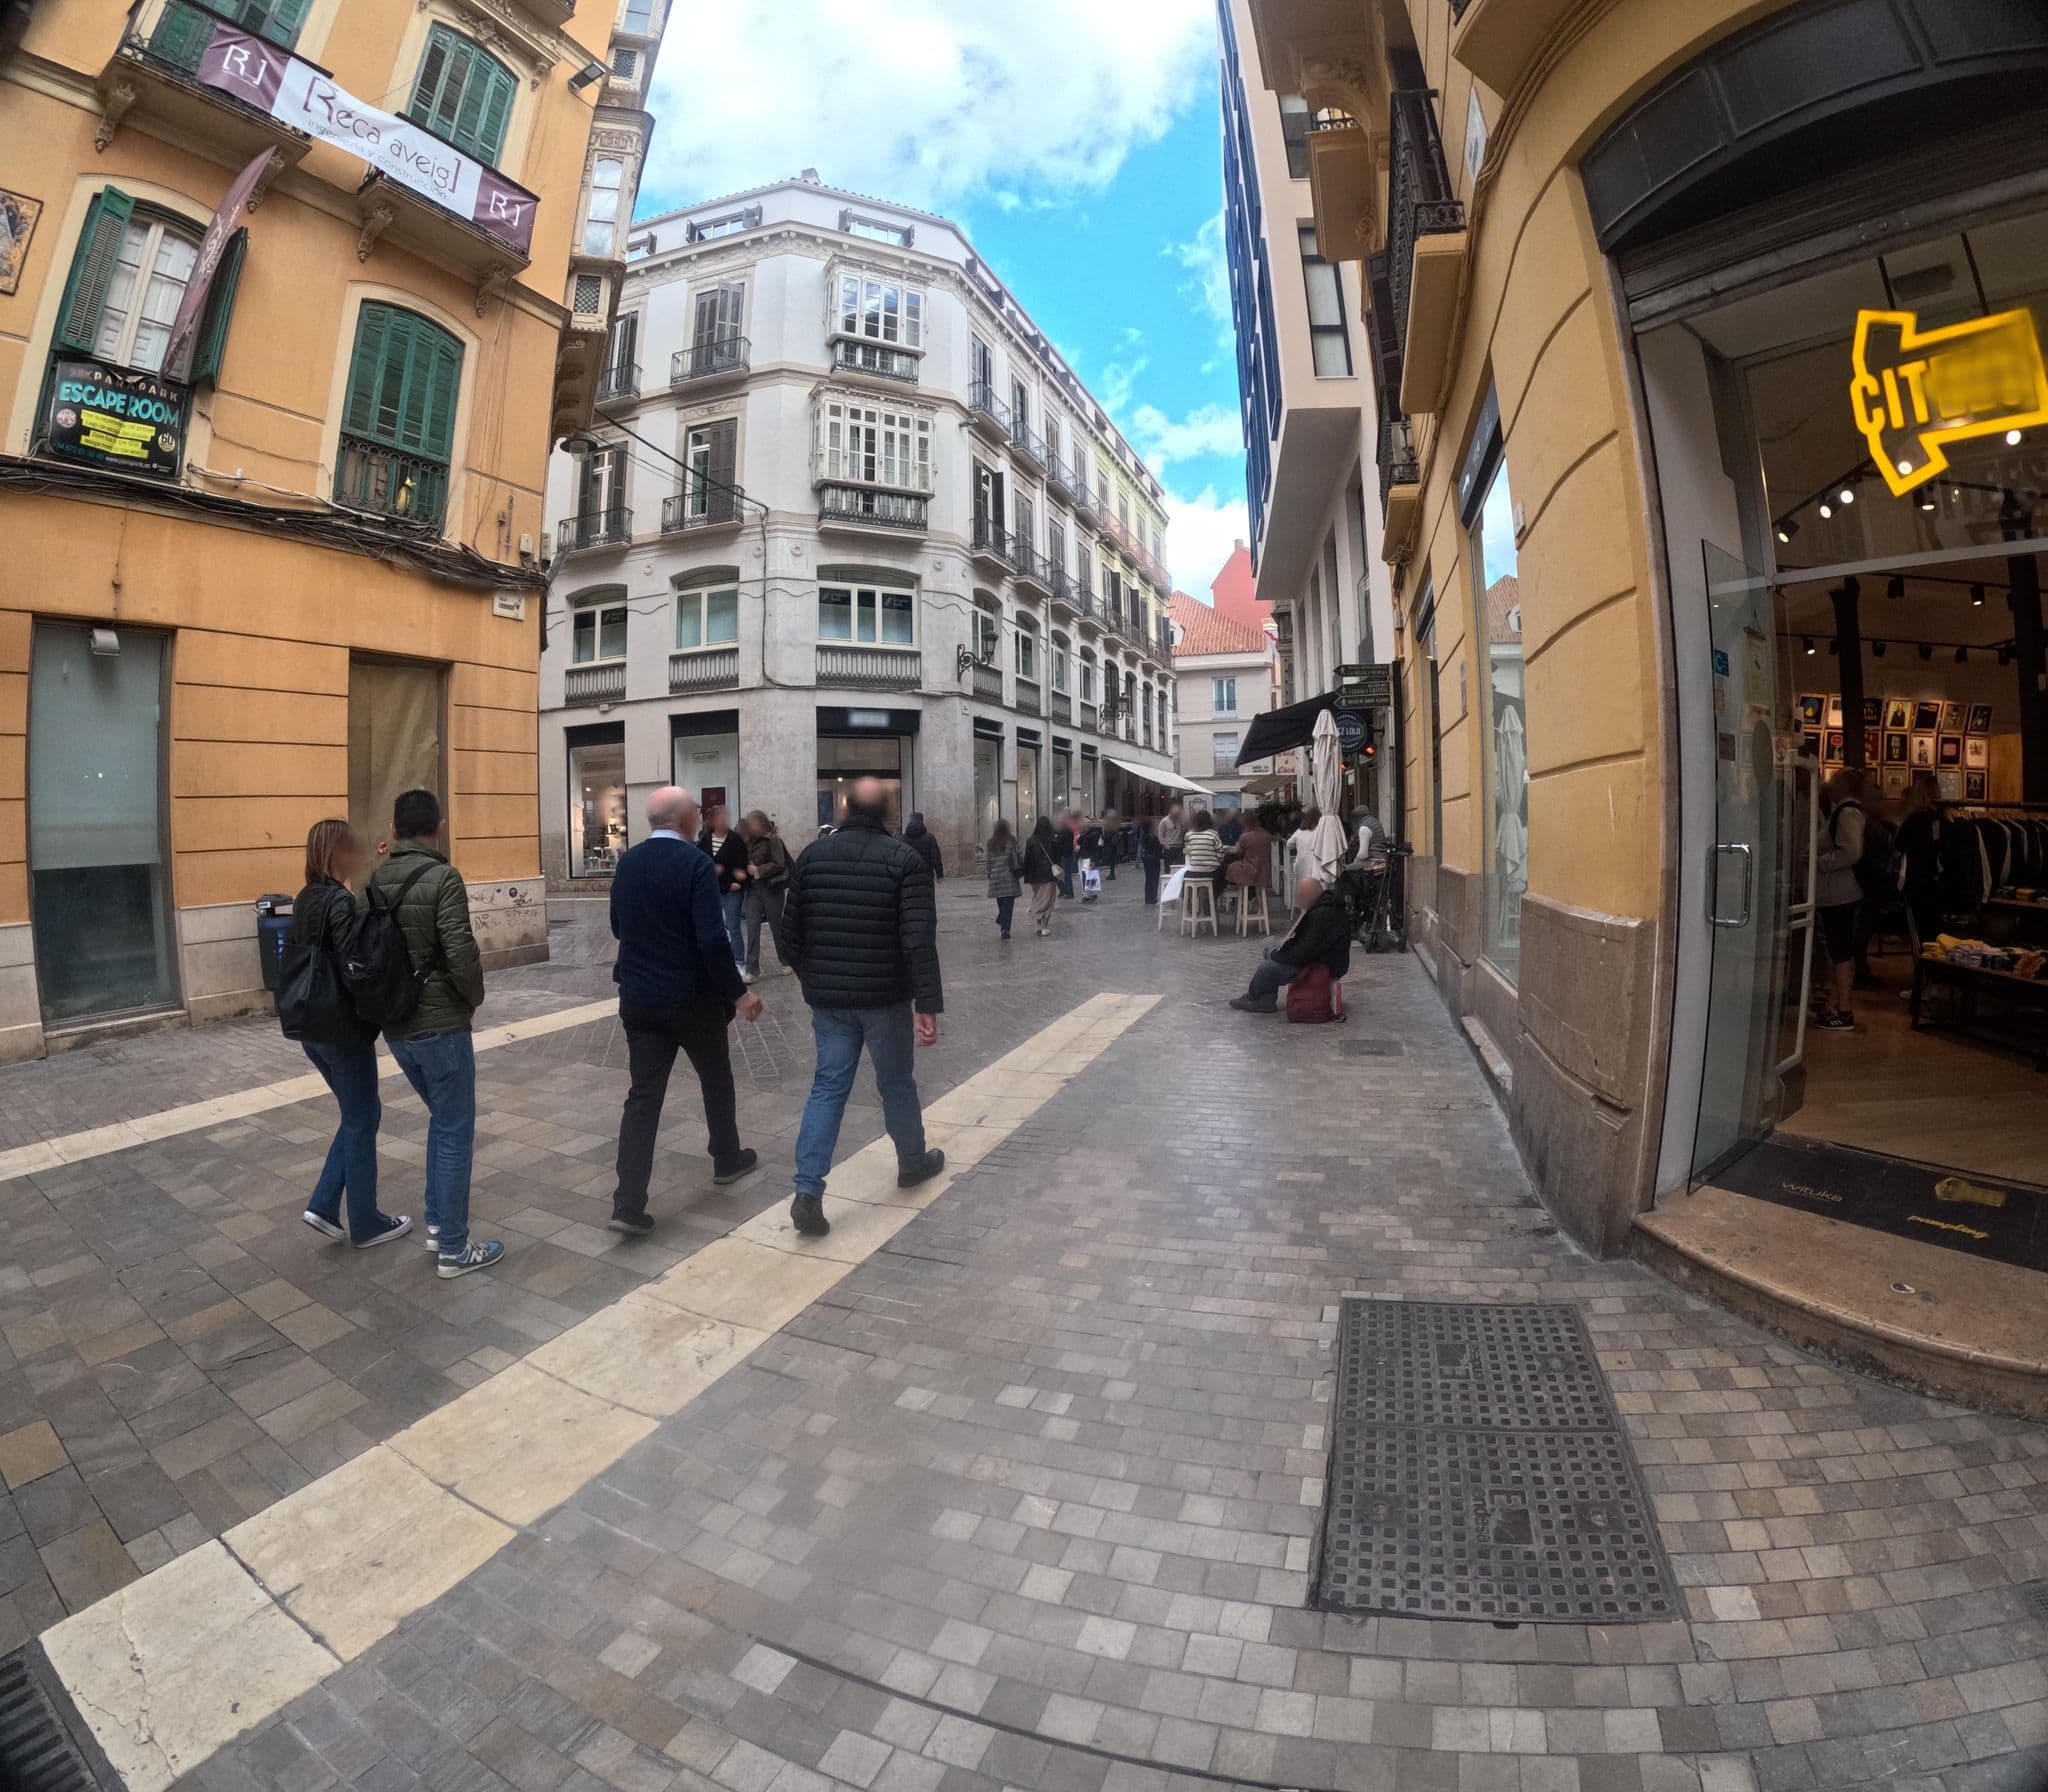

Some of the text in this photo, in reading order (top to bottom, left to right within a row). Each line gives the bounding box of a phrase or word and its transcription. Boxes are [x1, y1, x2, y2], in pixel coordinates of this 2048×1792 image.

[59, 380, 127, 414] ESCAPE
[126, 395, 180, 428] ROOM
[1345, 727, 1361, 736] LOLA
[1906, 1215, 1990, 1239] pampling
[1472, 1488, 1492, 1544] endesa
